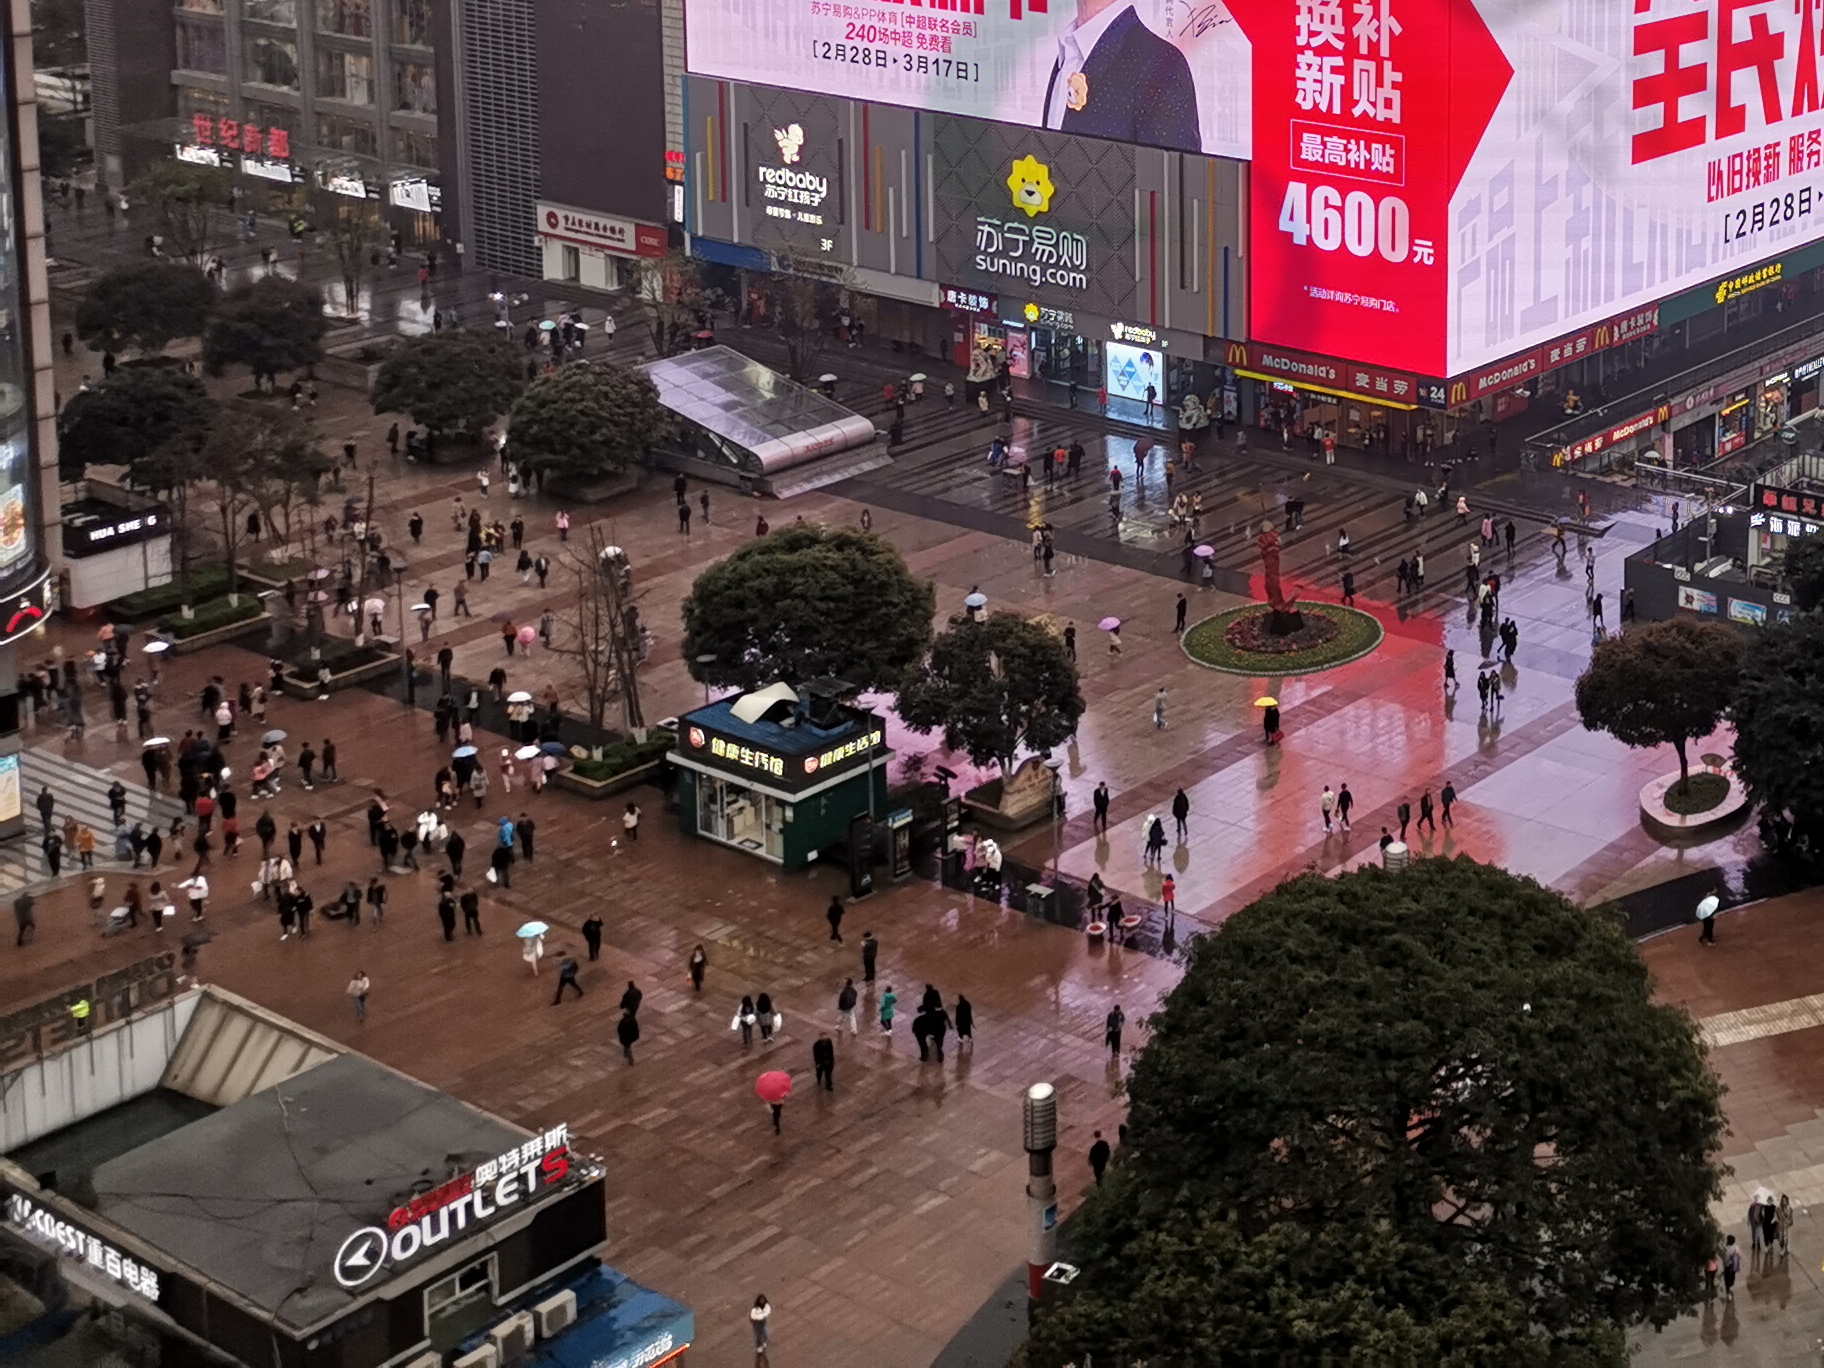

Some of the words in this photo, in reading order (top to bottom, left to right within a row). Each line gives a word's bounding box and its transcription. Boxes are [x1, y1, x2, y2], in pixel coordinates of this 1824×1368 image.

[811, 0, 897, 26] 苏宁易购&PP体育
[844, 22, 914, 50] 240场中超
[916, 31, 952, 54] 免费看
[1299, 129, 1396, 176] 最高补贴
[758, 166, 827, 199] redbaby
[1707, 140, 1782, 204] 以旧换新
[764, 184, 822, 207] 苏宁红孩子
[820, 238, 834, 252] 3F
[975, 216, 1087, 271] 苏宁易购
[975, 251, 1087, 291] suning.com
[1550, 337, 1588, 364] 麦当劳
[1262, 353, 1336, 381] McDonald's
[1478, 358, 1536, 391] McDonald's
[1355, 372, 1409, 397] 麦当劳
[1430, 386, 1446, 400] 24
[1612, 416, 1654, 442] McDonald's
[90, 527, 115, 542] HUA
[118, 514, 157, 534] SHEG
[711, 736, 785, 777] 健康生活馆
[475, 1121, 567, 1188] 奥特莱斯
[391, 1144, 569, 1262] OUTLETS
